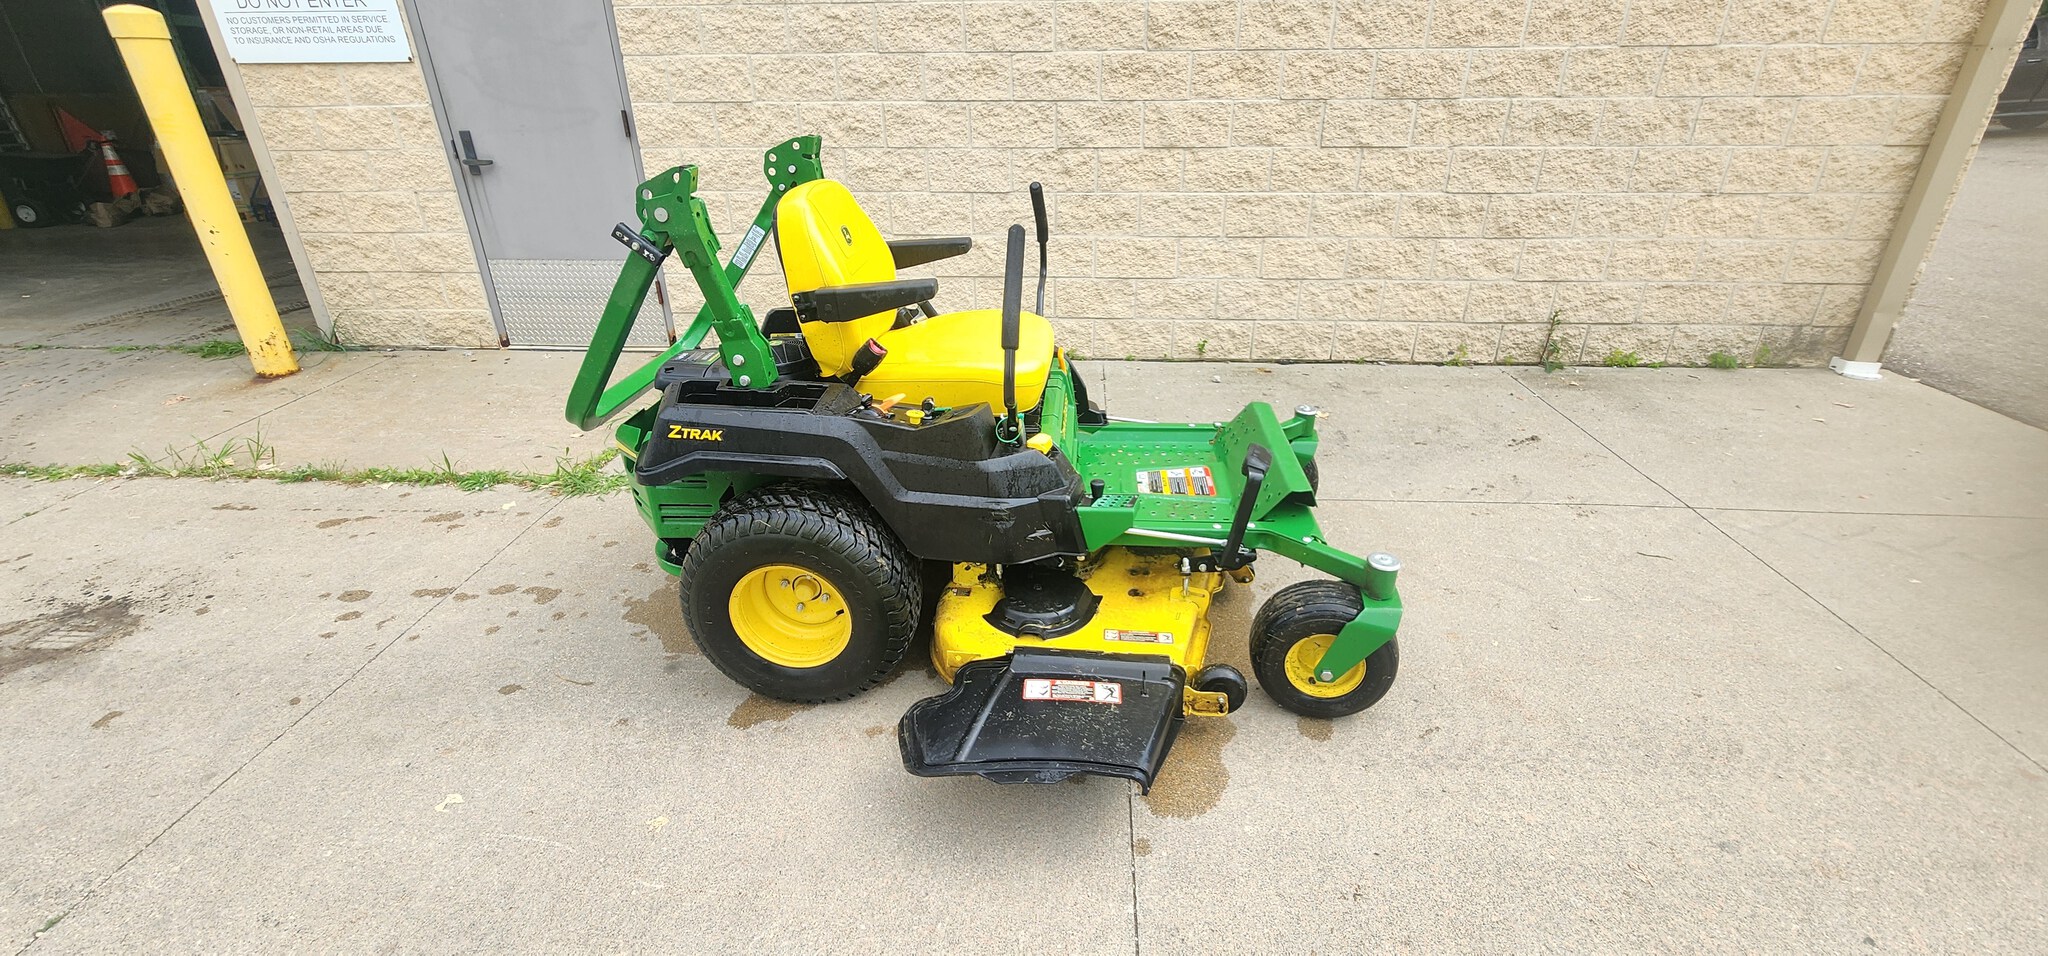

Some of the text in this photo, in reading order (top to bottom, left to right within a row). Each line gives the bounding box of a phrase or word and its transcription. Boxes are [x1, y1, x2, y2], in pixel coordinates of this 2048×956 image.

[226, 17, 239, 25] NO
[240, 16, 291, 25] CUSTOMERS
[292, 15, 340, 24] PERMITTED
[341, 15, 350, 24] IN
[230, 25, 384, 35] STORAGE, OR NON-RETAIL AREAS DUE
[233, 35, 396, 45] TO INSURANCE AND OSHA REGULATIONS
[668, 424, 723, 441] ZTRAK
